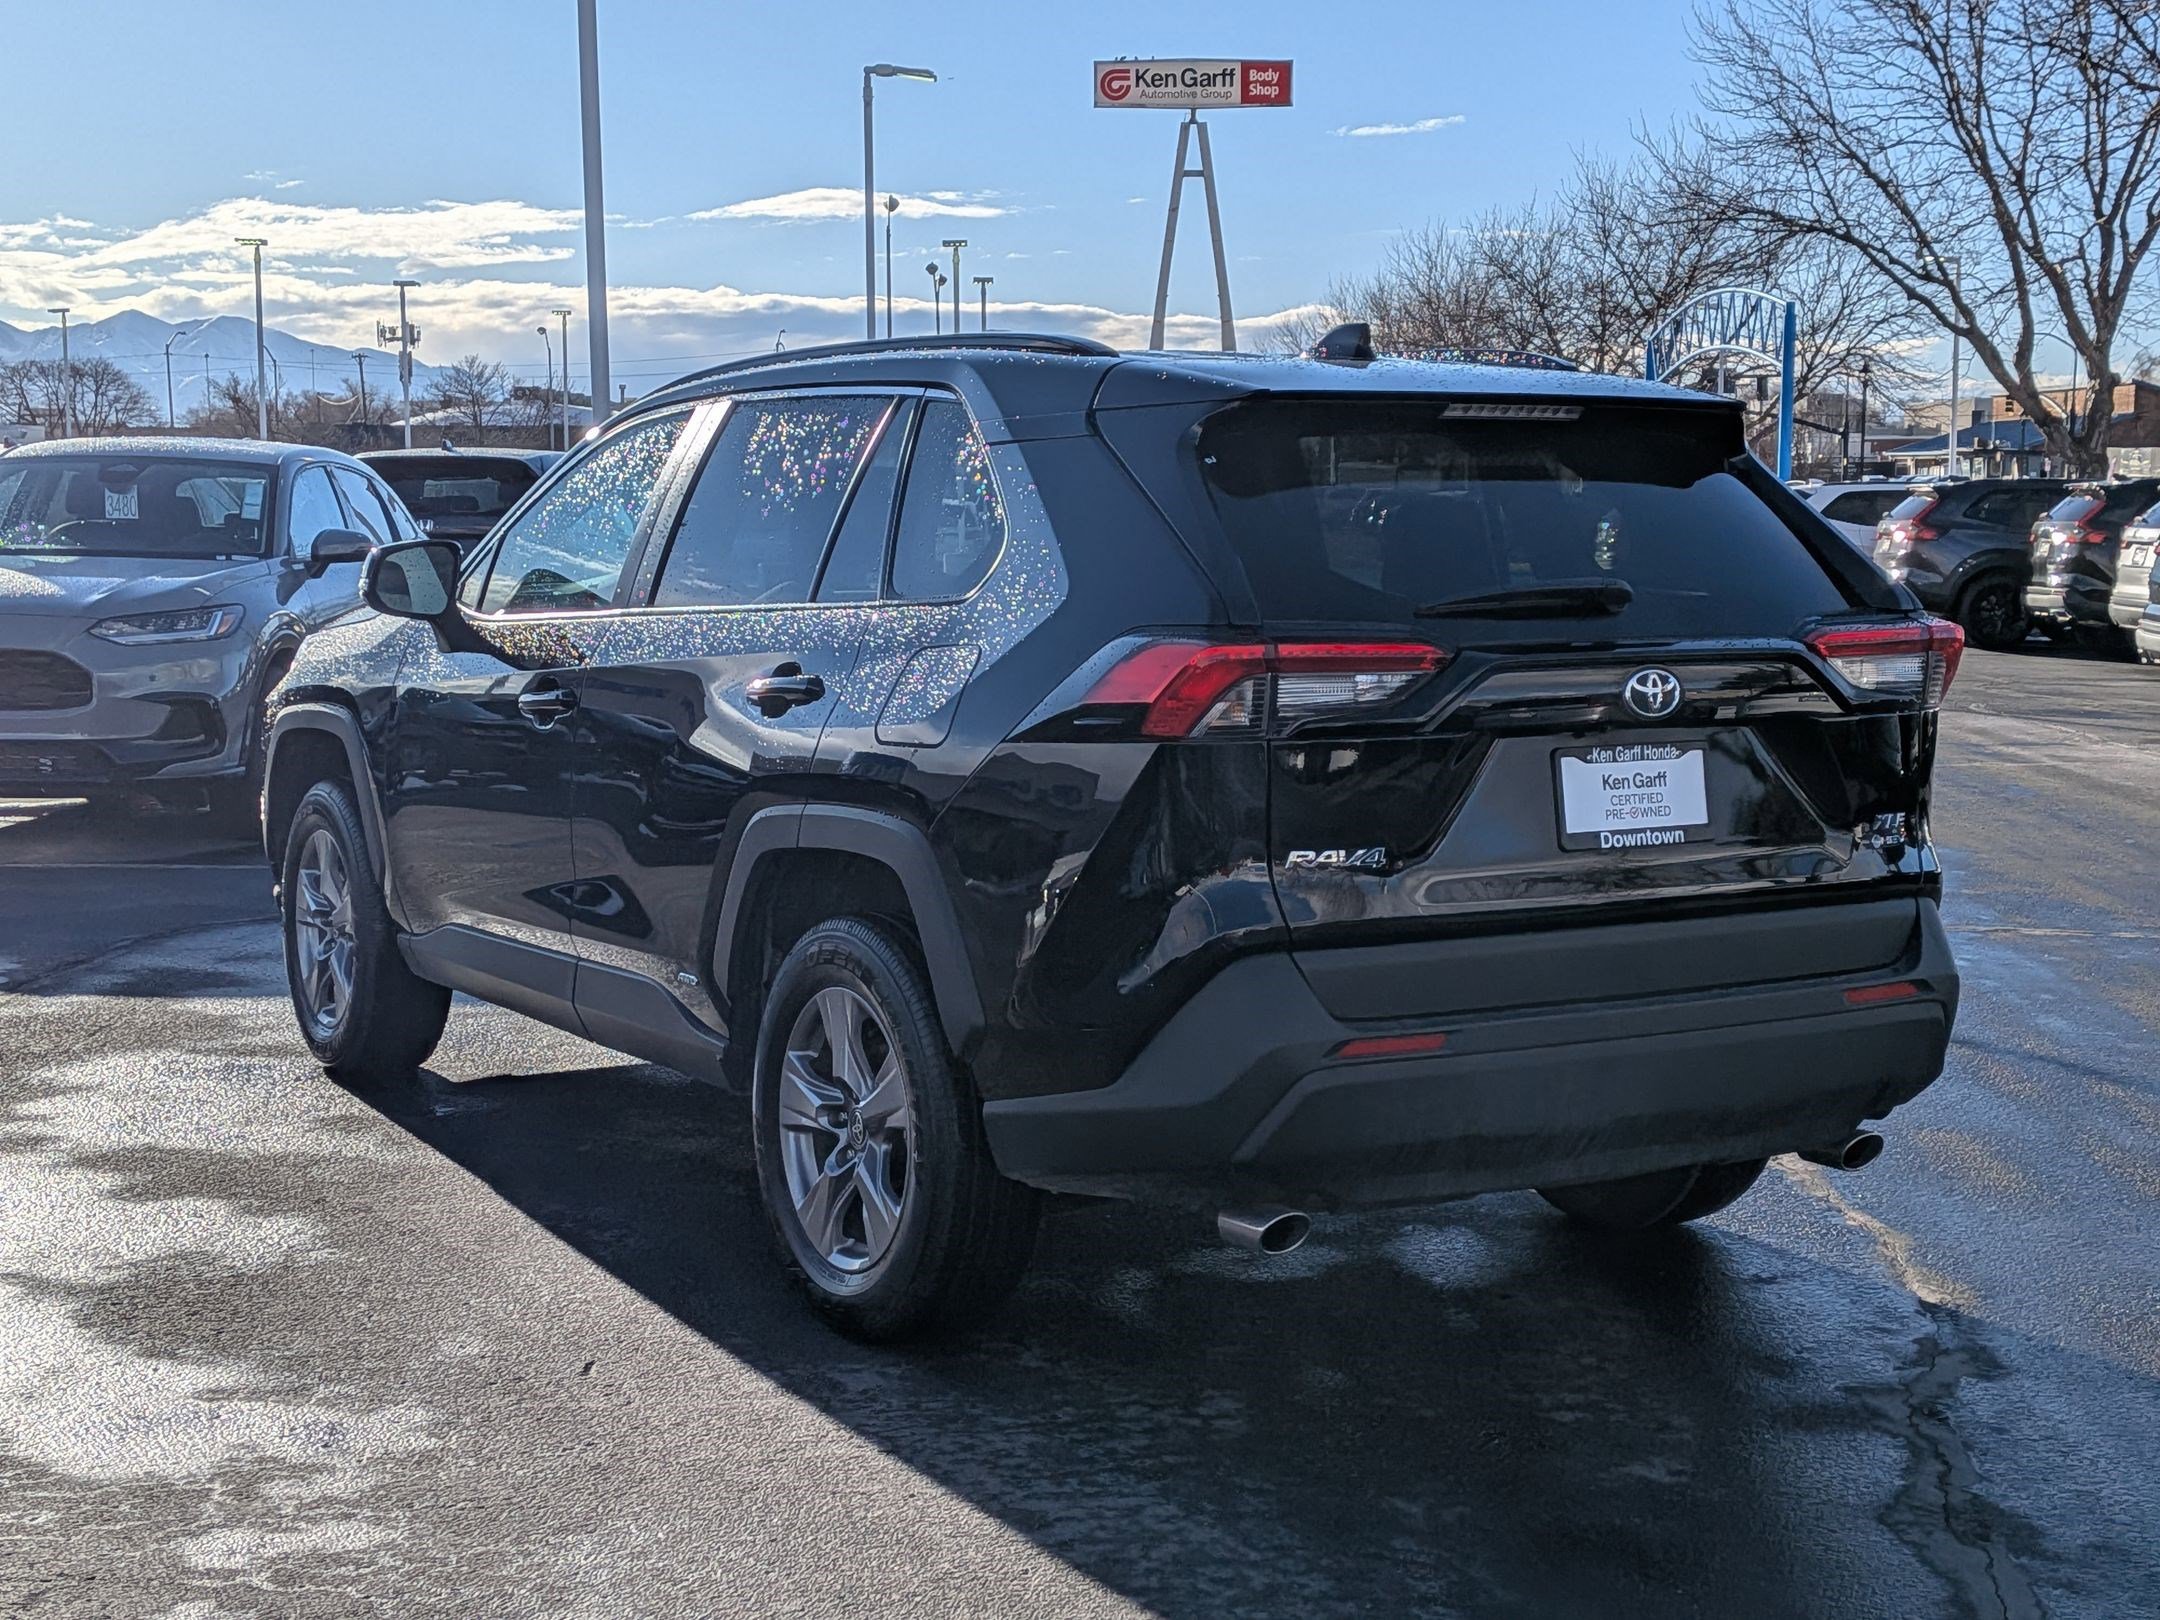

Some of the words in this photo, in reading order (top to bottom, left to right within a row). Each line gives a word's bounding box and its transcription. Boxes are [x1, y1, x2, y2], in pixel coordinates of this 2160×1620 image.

[1135, 68, 1177, 88] Ken
[1181, 67, 1236, 88] Garff
[1249, 68, 1280, 84] Body
[1139, 89, 1198, 99] Automotive
[1200, 88, 1233, 100] Group
[1249, 83, 1280, 98] Shop
[106, 495, 137, 517] 3480
[1592, 747, 1613, 763] Ken
[1615, 745, 1642, 762] Garff
[1643, 743, 1677, 761] Honda
[1602, 773, 1631, 791] Ken
[1633, 771, 1668, 789] Garff
[1610, 792, 1664, 806] CERTIFIED
[1600, 829, 1685, 849] Downtown
[1284, 847, 1386, 869] RAV4
